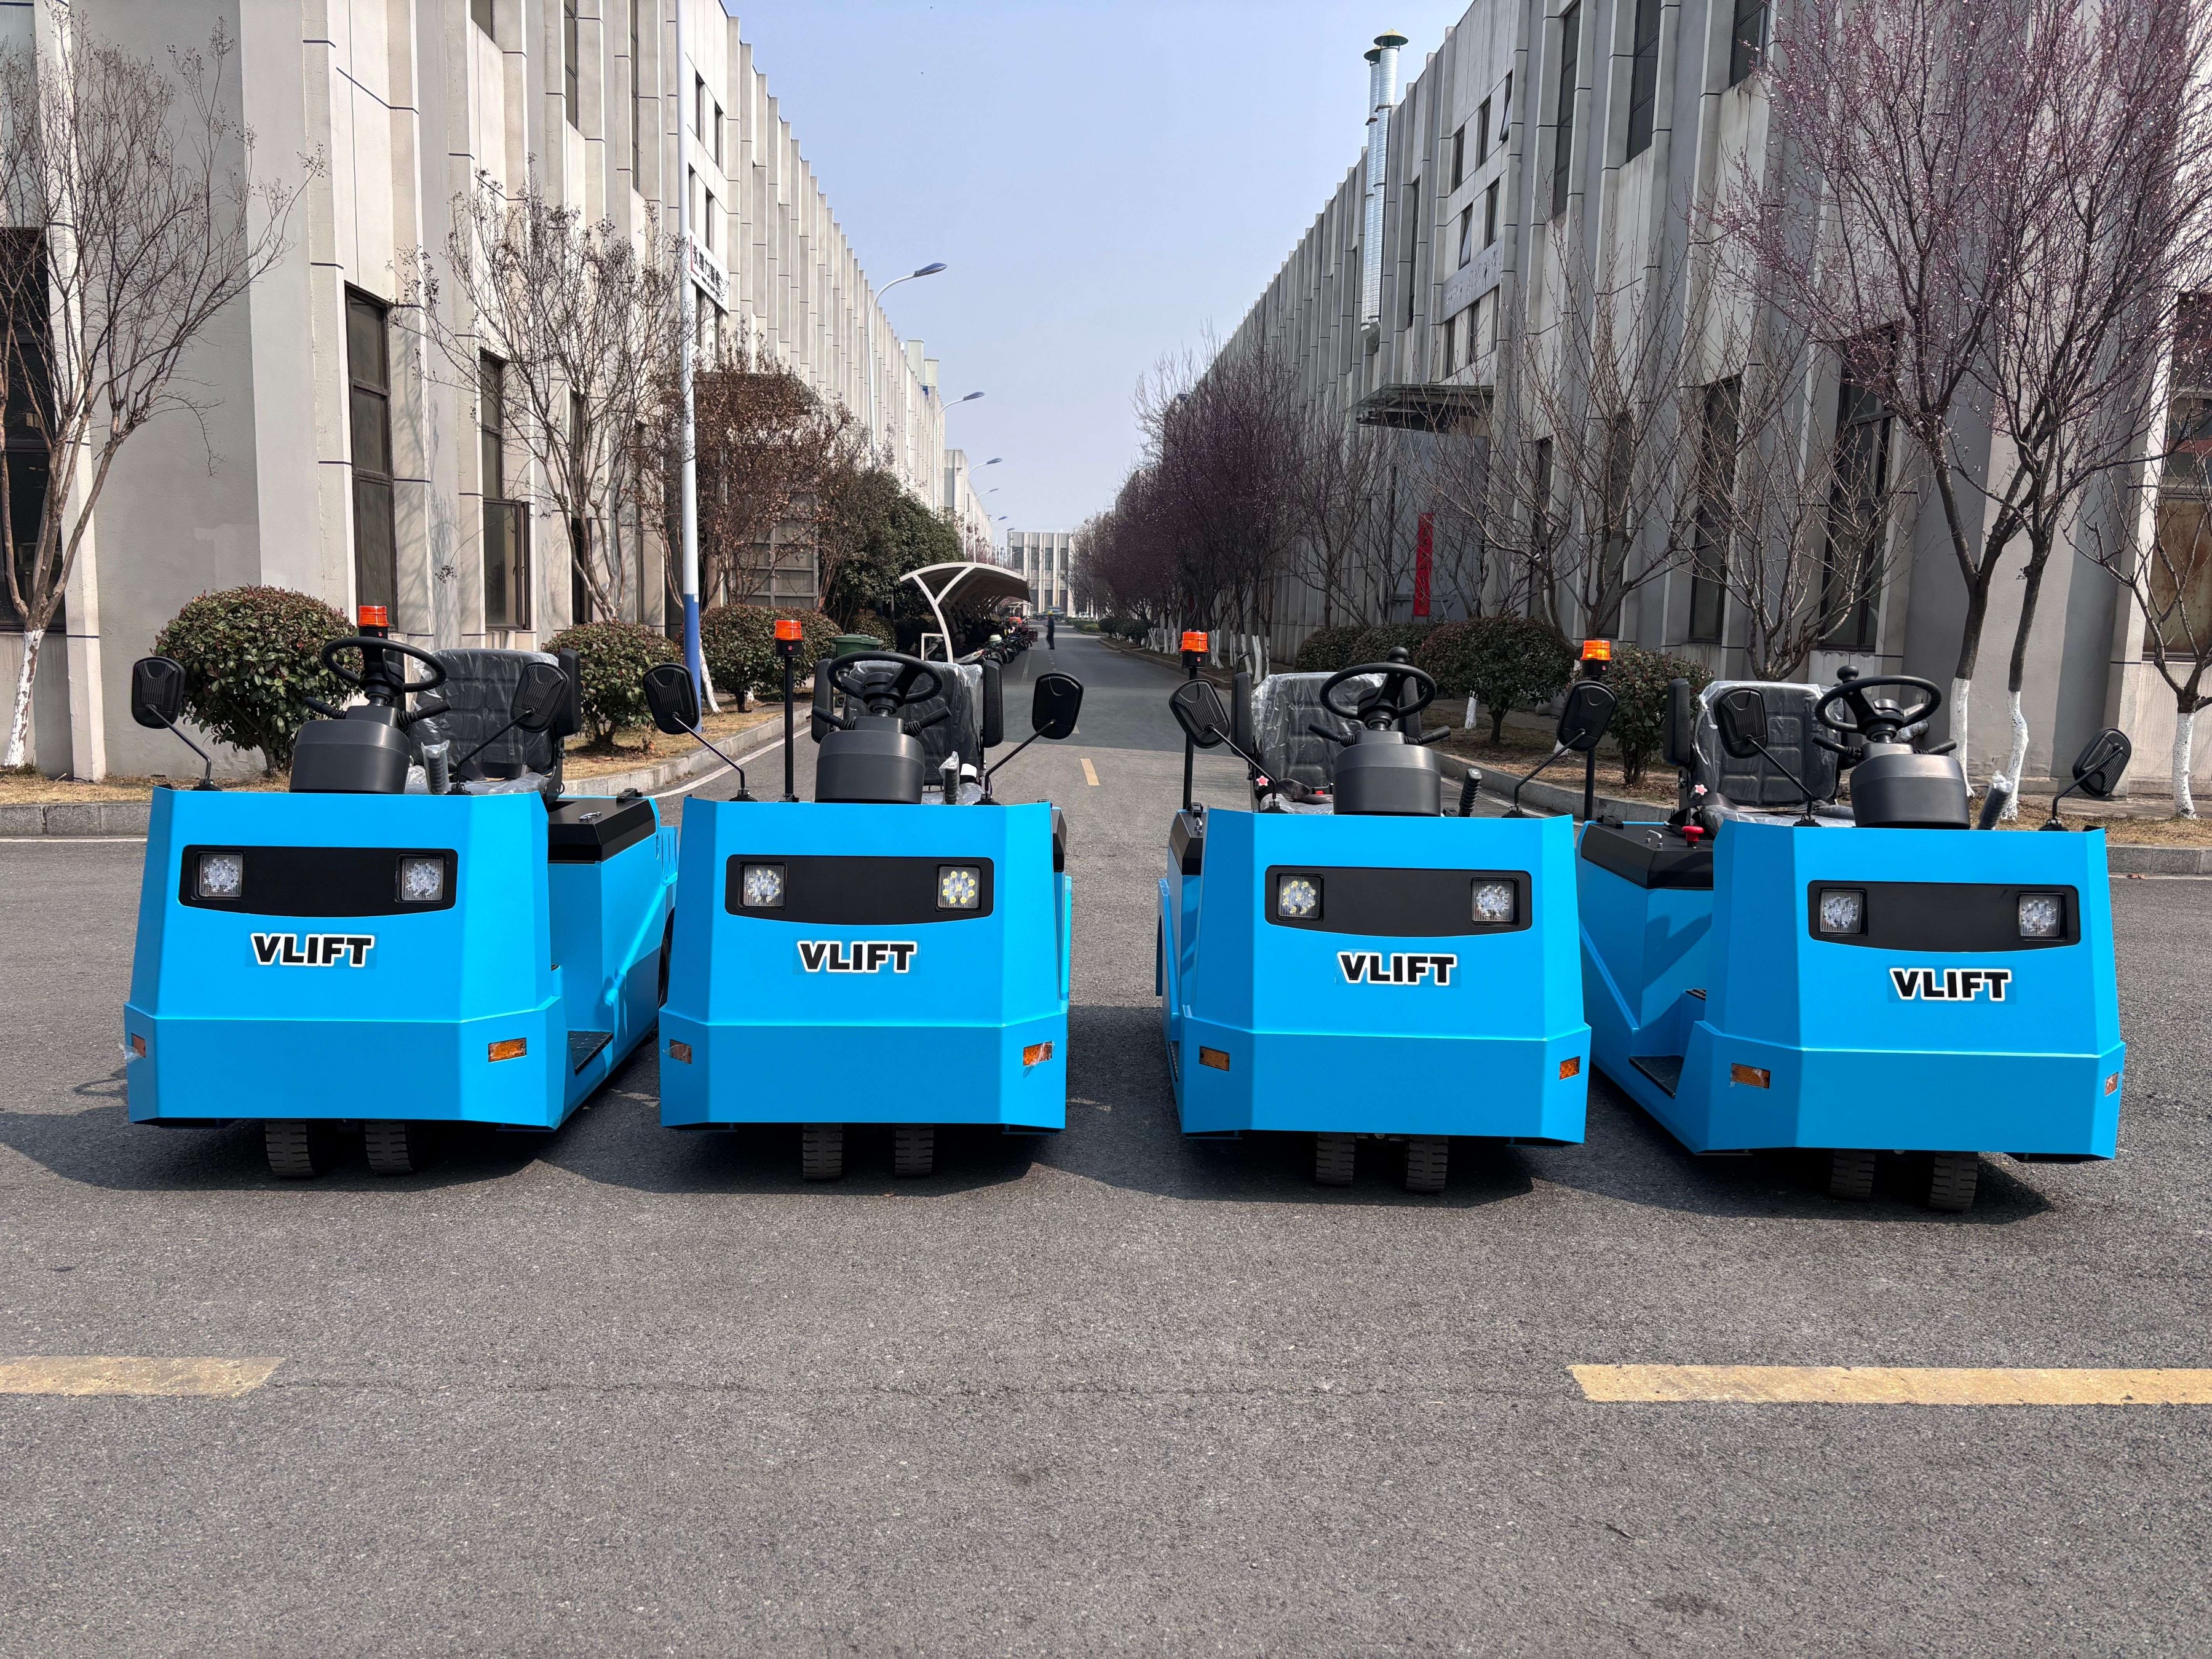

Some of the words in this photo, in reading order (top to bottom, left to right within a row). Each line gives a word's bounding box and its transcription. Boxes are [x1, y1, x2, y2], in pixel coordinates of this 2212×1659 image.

[252, 935, 373, 965] VLIFT
[799, 943, 916, 972] VLIFT
[1339, 954, 1455, 984] VLIFT
[1892, 970, 2010, 1000] VLIFT
